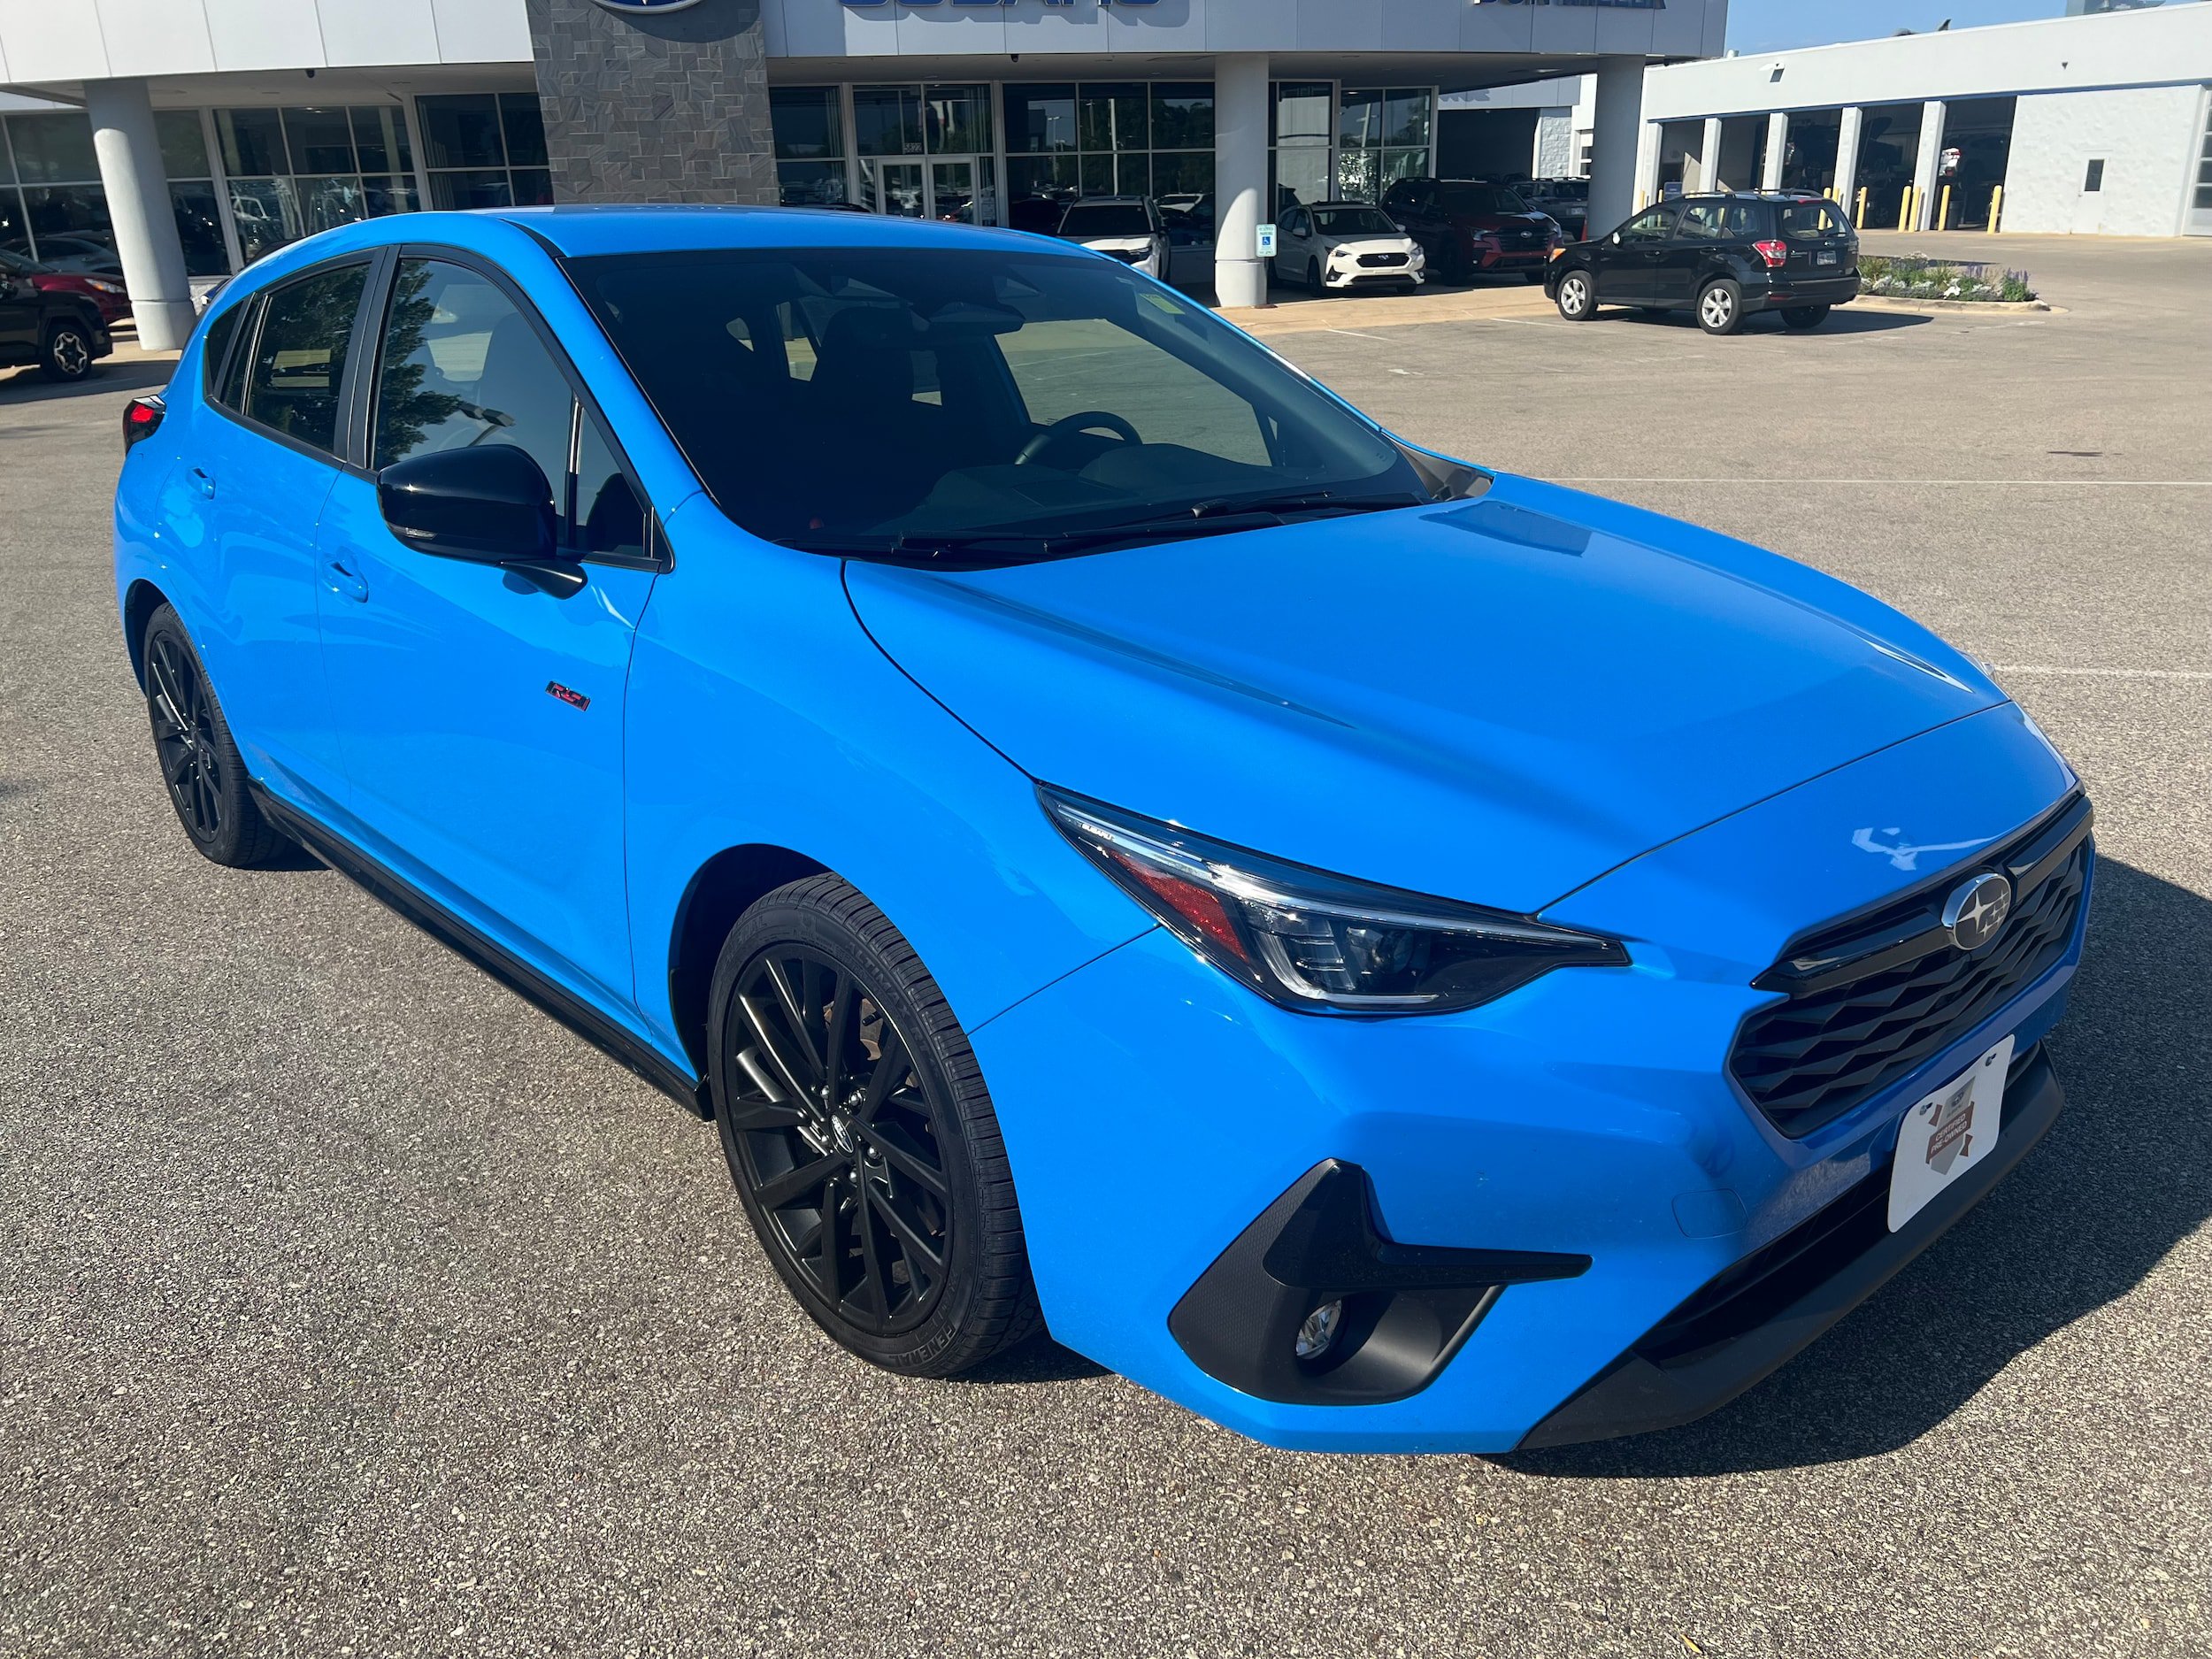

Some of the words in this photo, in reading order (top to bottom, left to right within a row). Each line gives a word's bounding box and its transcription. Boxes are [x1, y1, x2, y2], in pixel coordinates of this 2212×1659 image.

[1081, 823, 1112, 840] SUBARU
[847, 941, 910, 1018] ALTIMAX
[1931, 1120, 1968, 1155] PRE-OWNED
[1935, 1113, 1966, 1141] CERTIFIED
